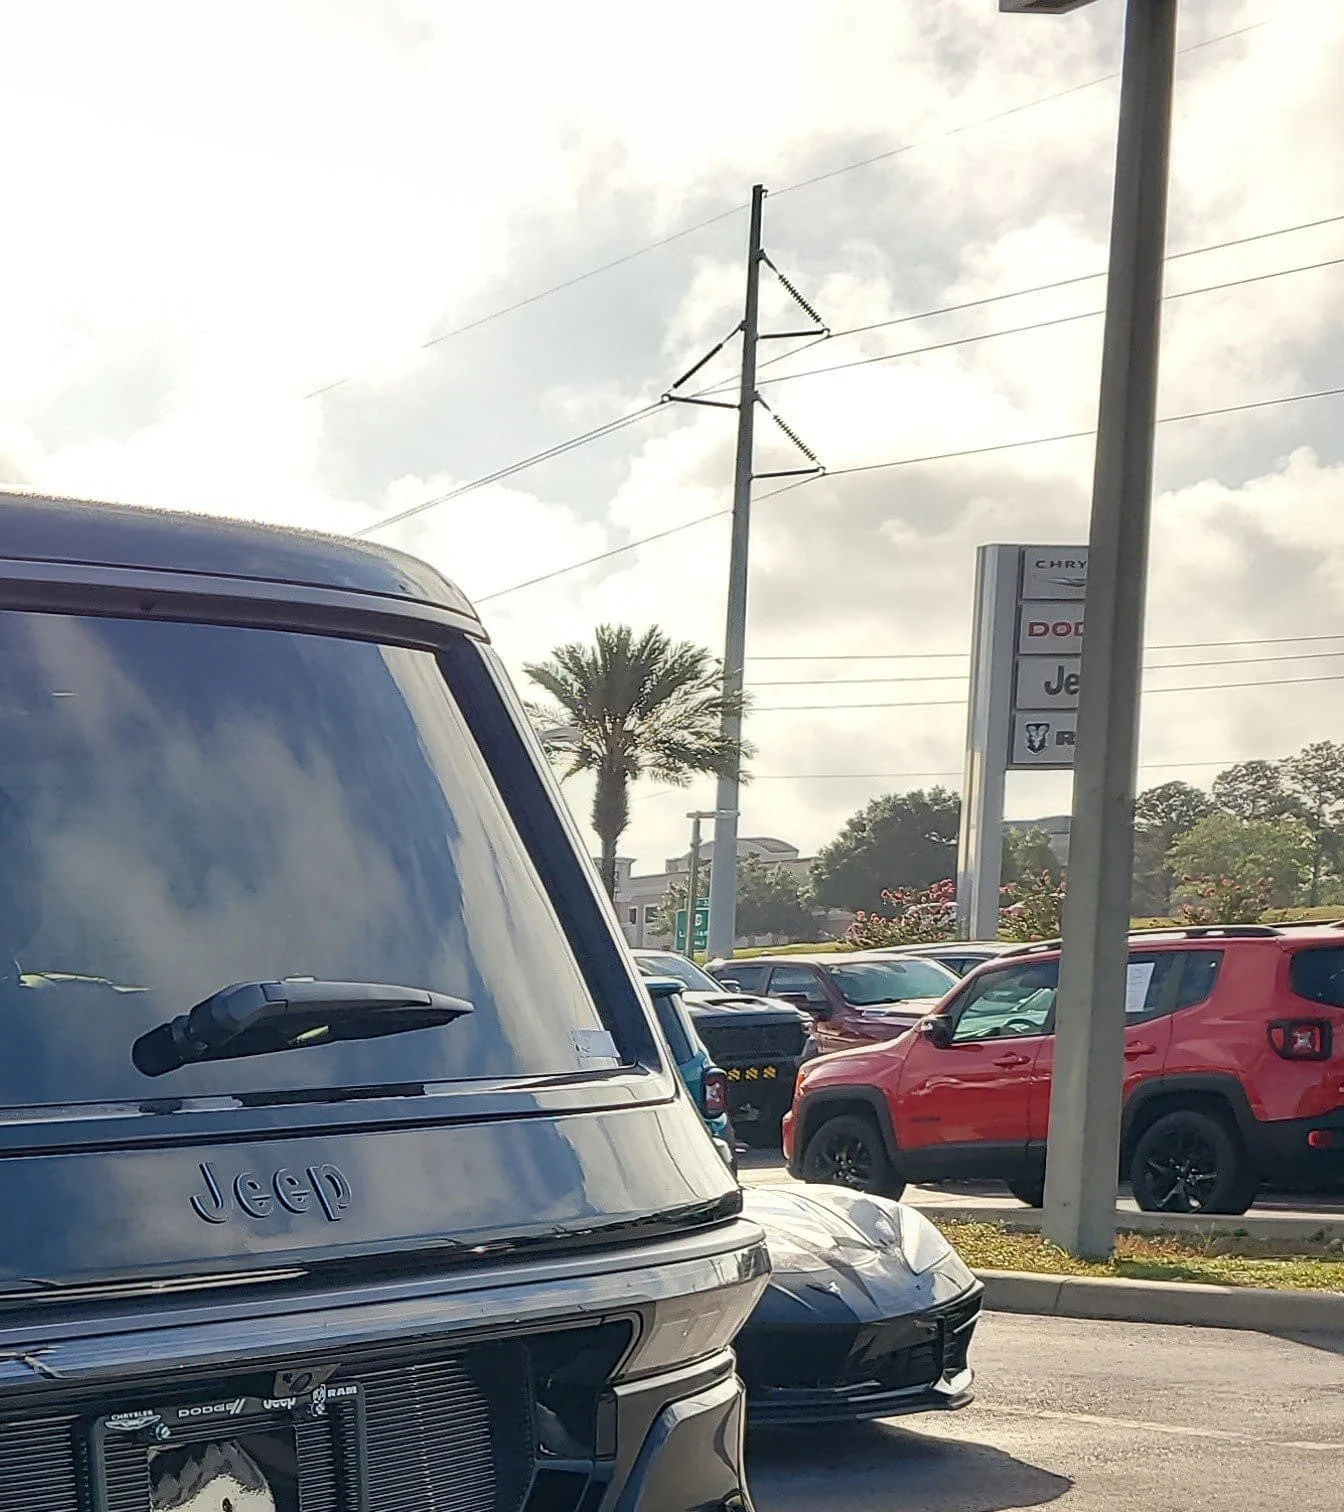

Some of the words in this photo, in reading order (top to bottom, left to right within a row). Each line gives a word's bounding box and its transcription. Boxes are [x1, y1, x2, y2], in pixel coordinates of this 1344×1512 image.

[1044, 665, 1080, 695] Je
[1055, 731, 1076, 745] R
[188, 1162, 352, 1225] Jeep
[178, 1402, 235, 1418] DODGE
[327, 1386, 357, 1397] RAM
